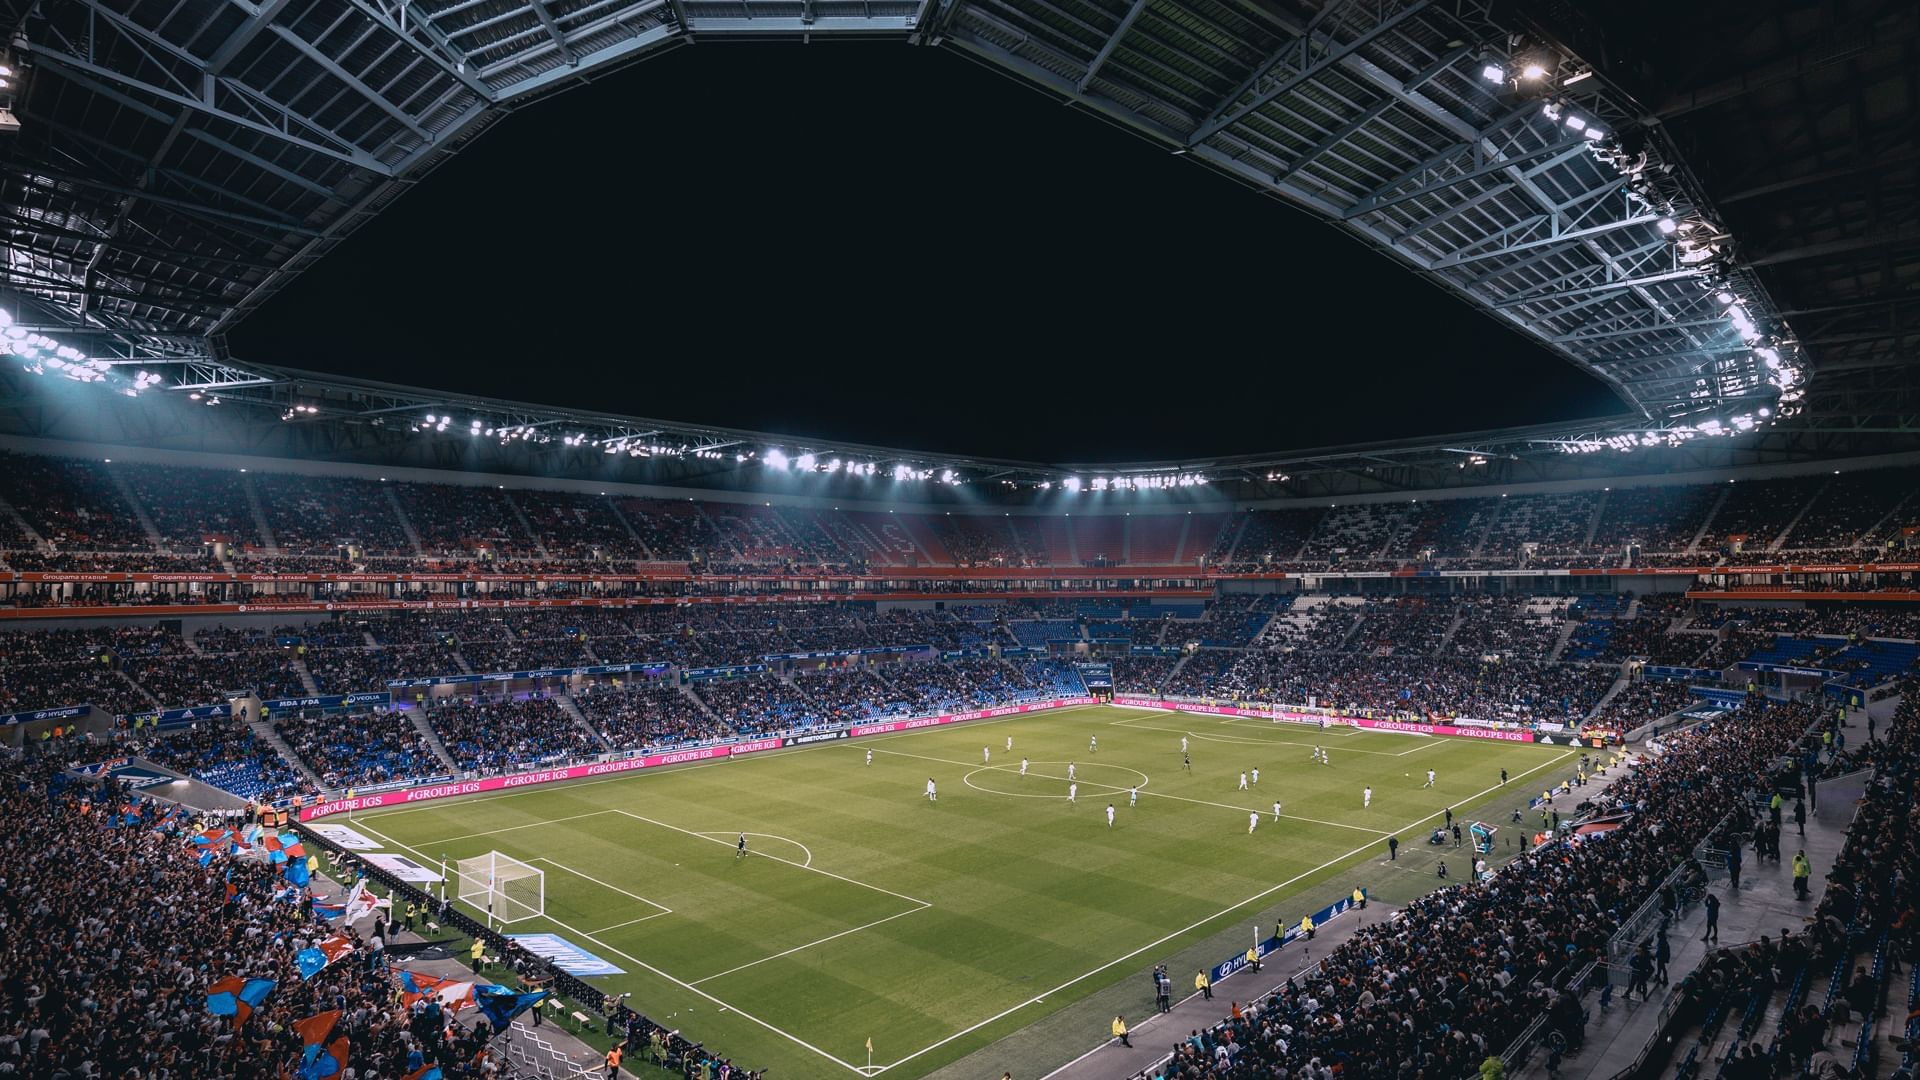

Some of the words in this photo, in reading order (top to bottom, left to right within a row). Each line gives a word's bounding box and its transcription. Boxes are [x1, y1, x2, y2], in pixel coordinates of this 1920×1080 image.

[42, 574, 80, 582] Groupama
[356, 694, 380, 702] VEOLIA
[279, 700, 298, 708] MDA
[48, 708, 79, 718] HYUNDAI
[1208, 705, 1220, 713] IGS
[1418, 724, 1434, 733] IGS
[1506, 733, 1523, 741] IGS
[764, 741, 776, 749] IGS
[700, 749, 713, 759] IGS
[630, 759, 645, 769] IGS
[552, 769, 568, 780] IGS
[462, 781, 480, 793] IGS
[362, 796, 383, 807] IGS
